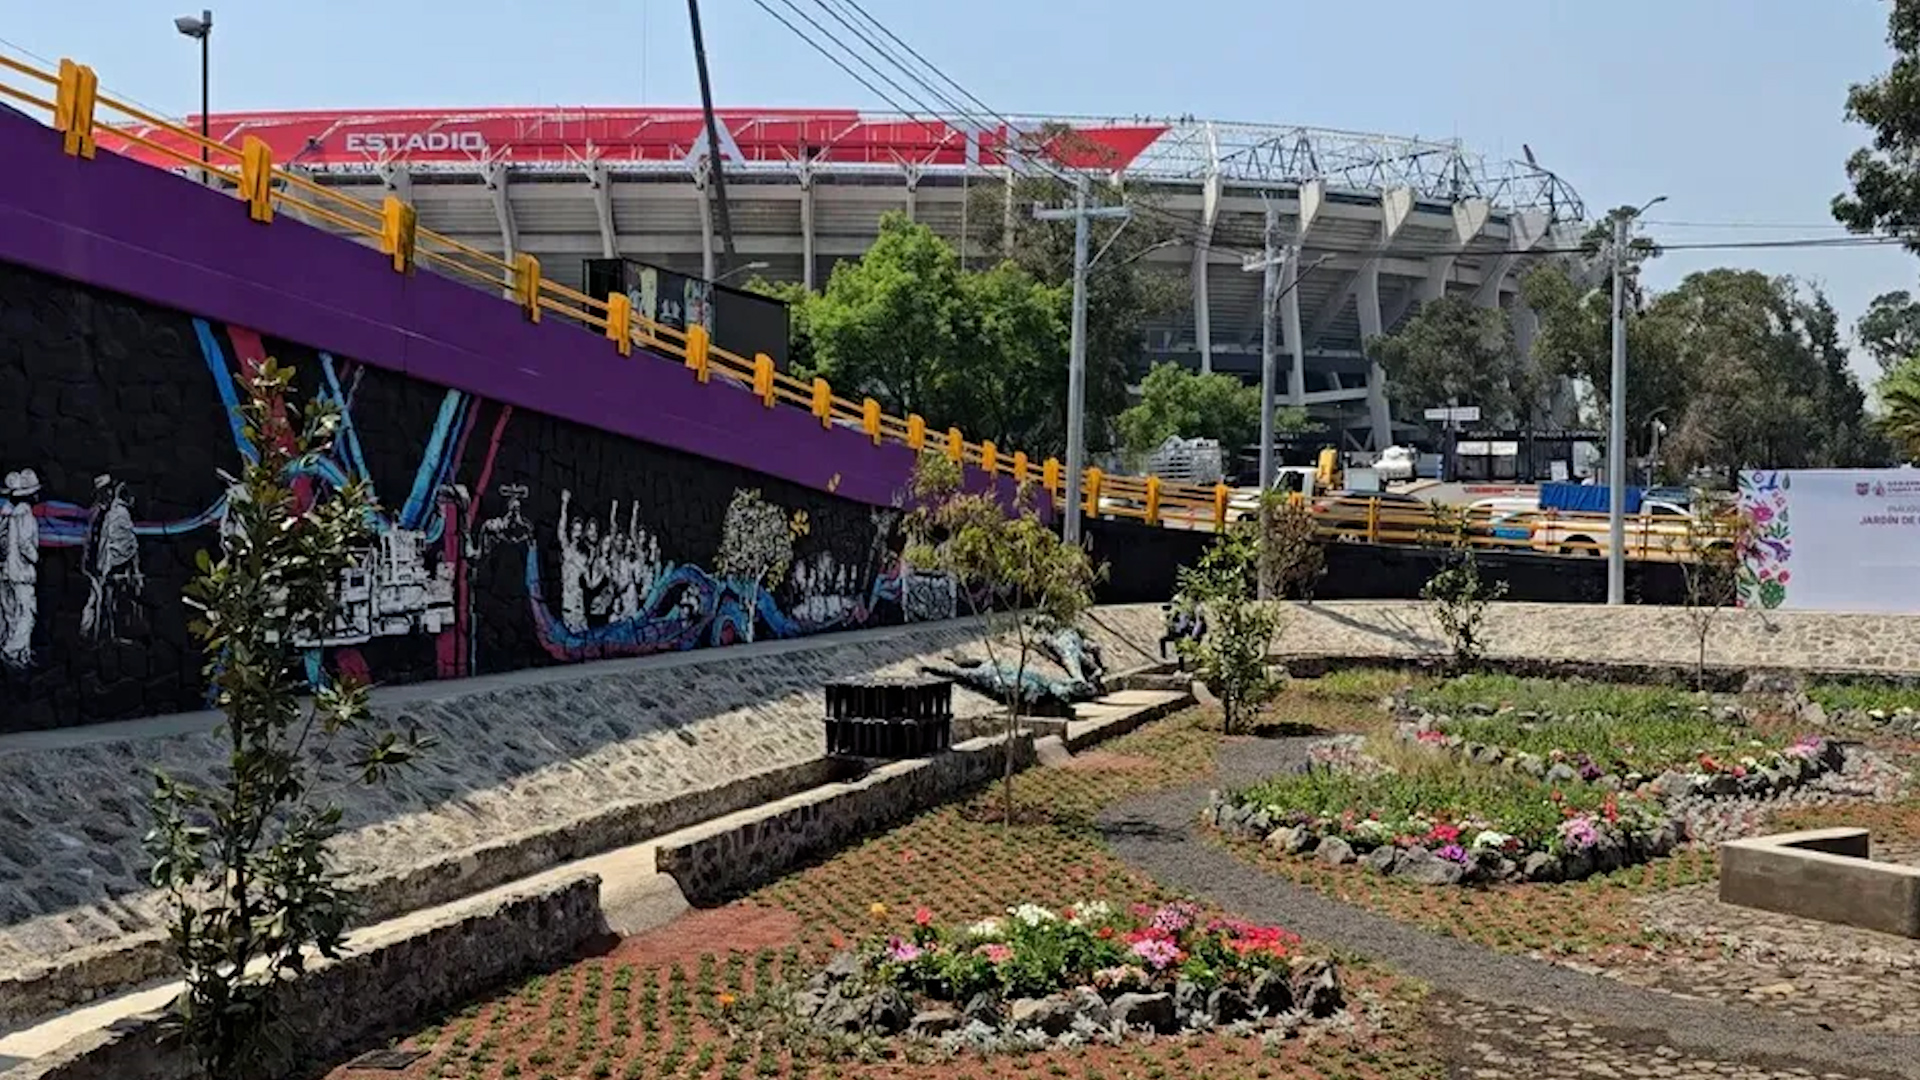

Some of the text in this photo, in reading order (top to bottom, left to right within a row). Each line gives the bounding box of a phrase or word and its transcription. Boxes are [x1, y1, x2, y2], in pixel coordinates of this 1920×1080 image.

[346, 131, 486, 152] ESTADIO
[1859, 514, 1915, 525] JARDÍN DE
